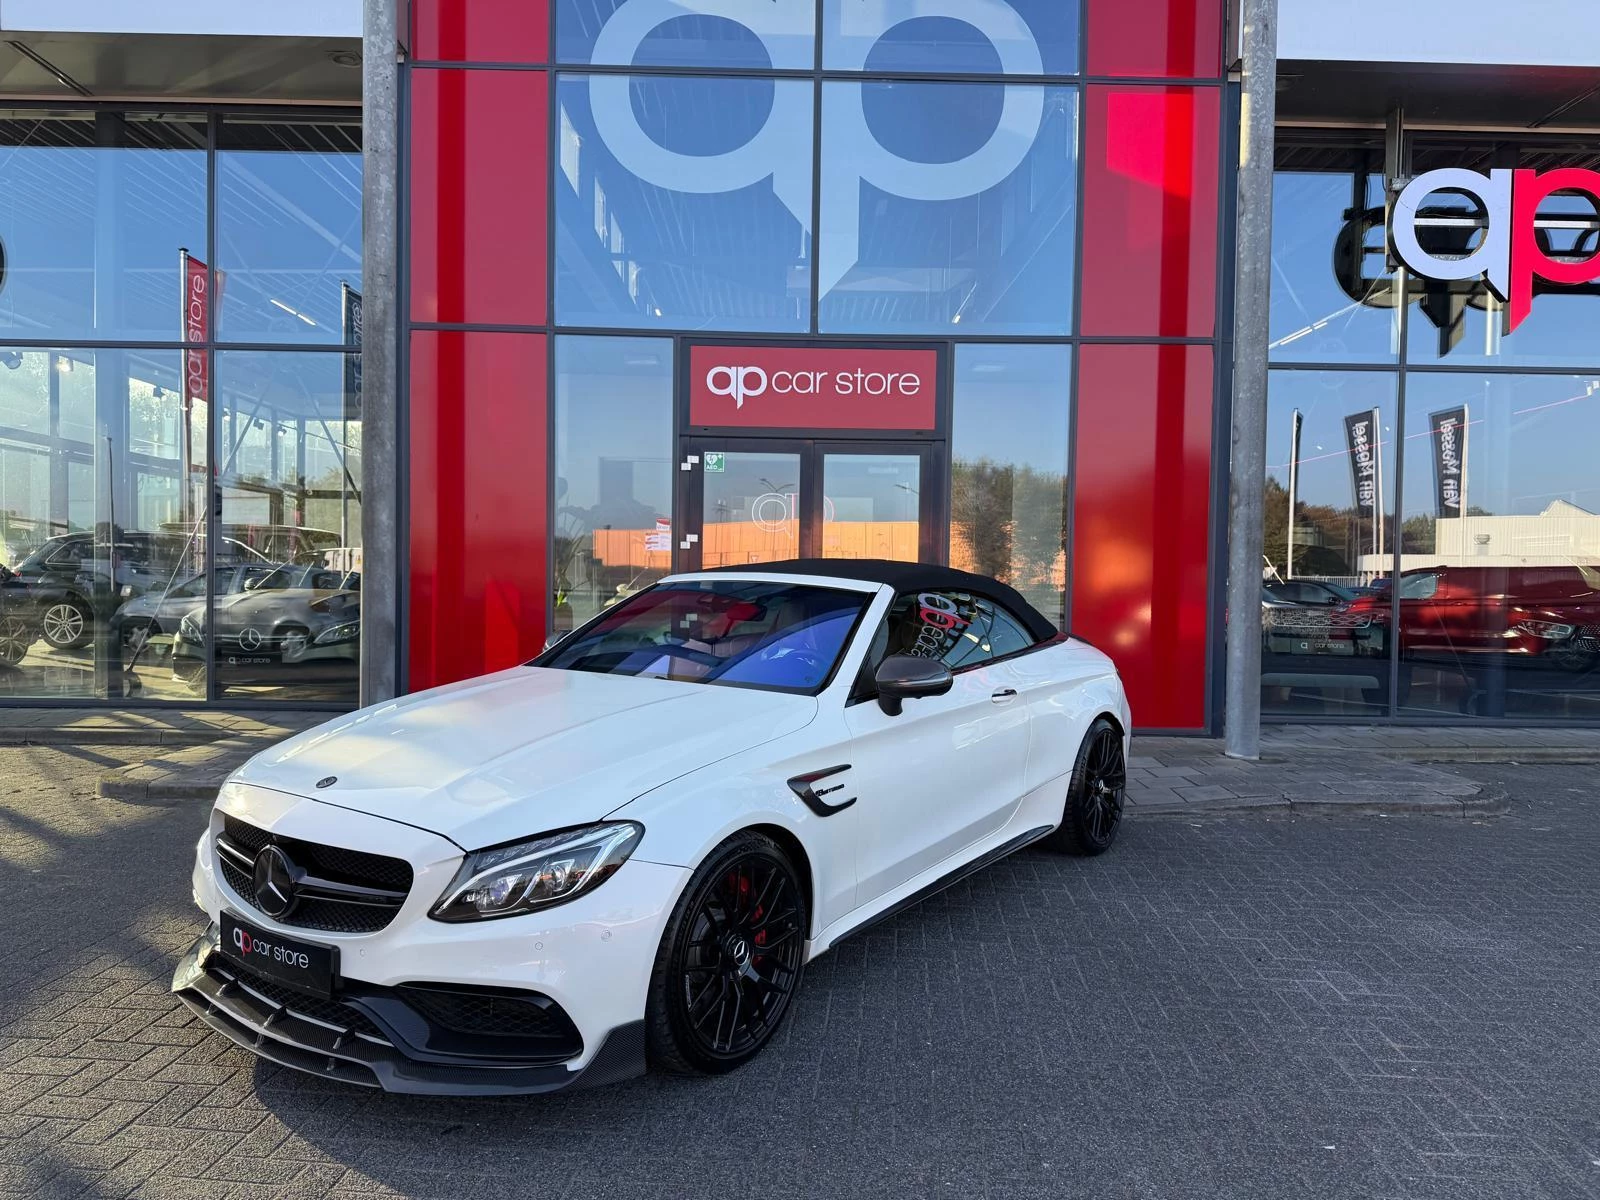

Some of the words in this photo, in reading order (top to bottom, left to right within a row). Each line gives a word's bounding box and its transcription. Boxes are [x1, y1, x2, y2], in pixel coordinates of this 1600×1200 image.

[706, 366, 768, 410] ap
[771, 370, 829, 394] car
[835, 368, 921, 395] store
[233, 927, 253, 957] ap
[252, 938, 271, 957] car
[273, 945, 309, 968] store
